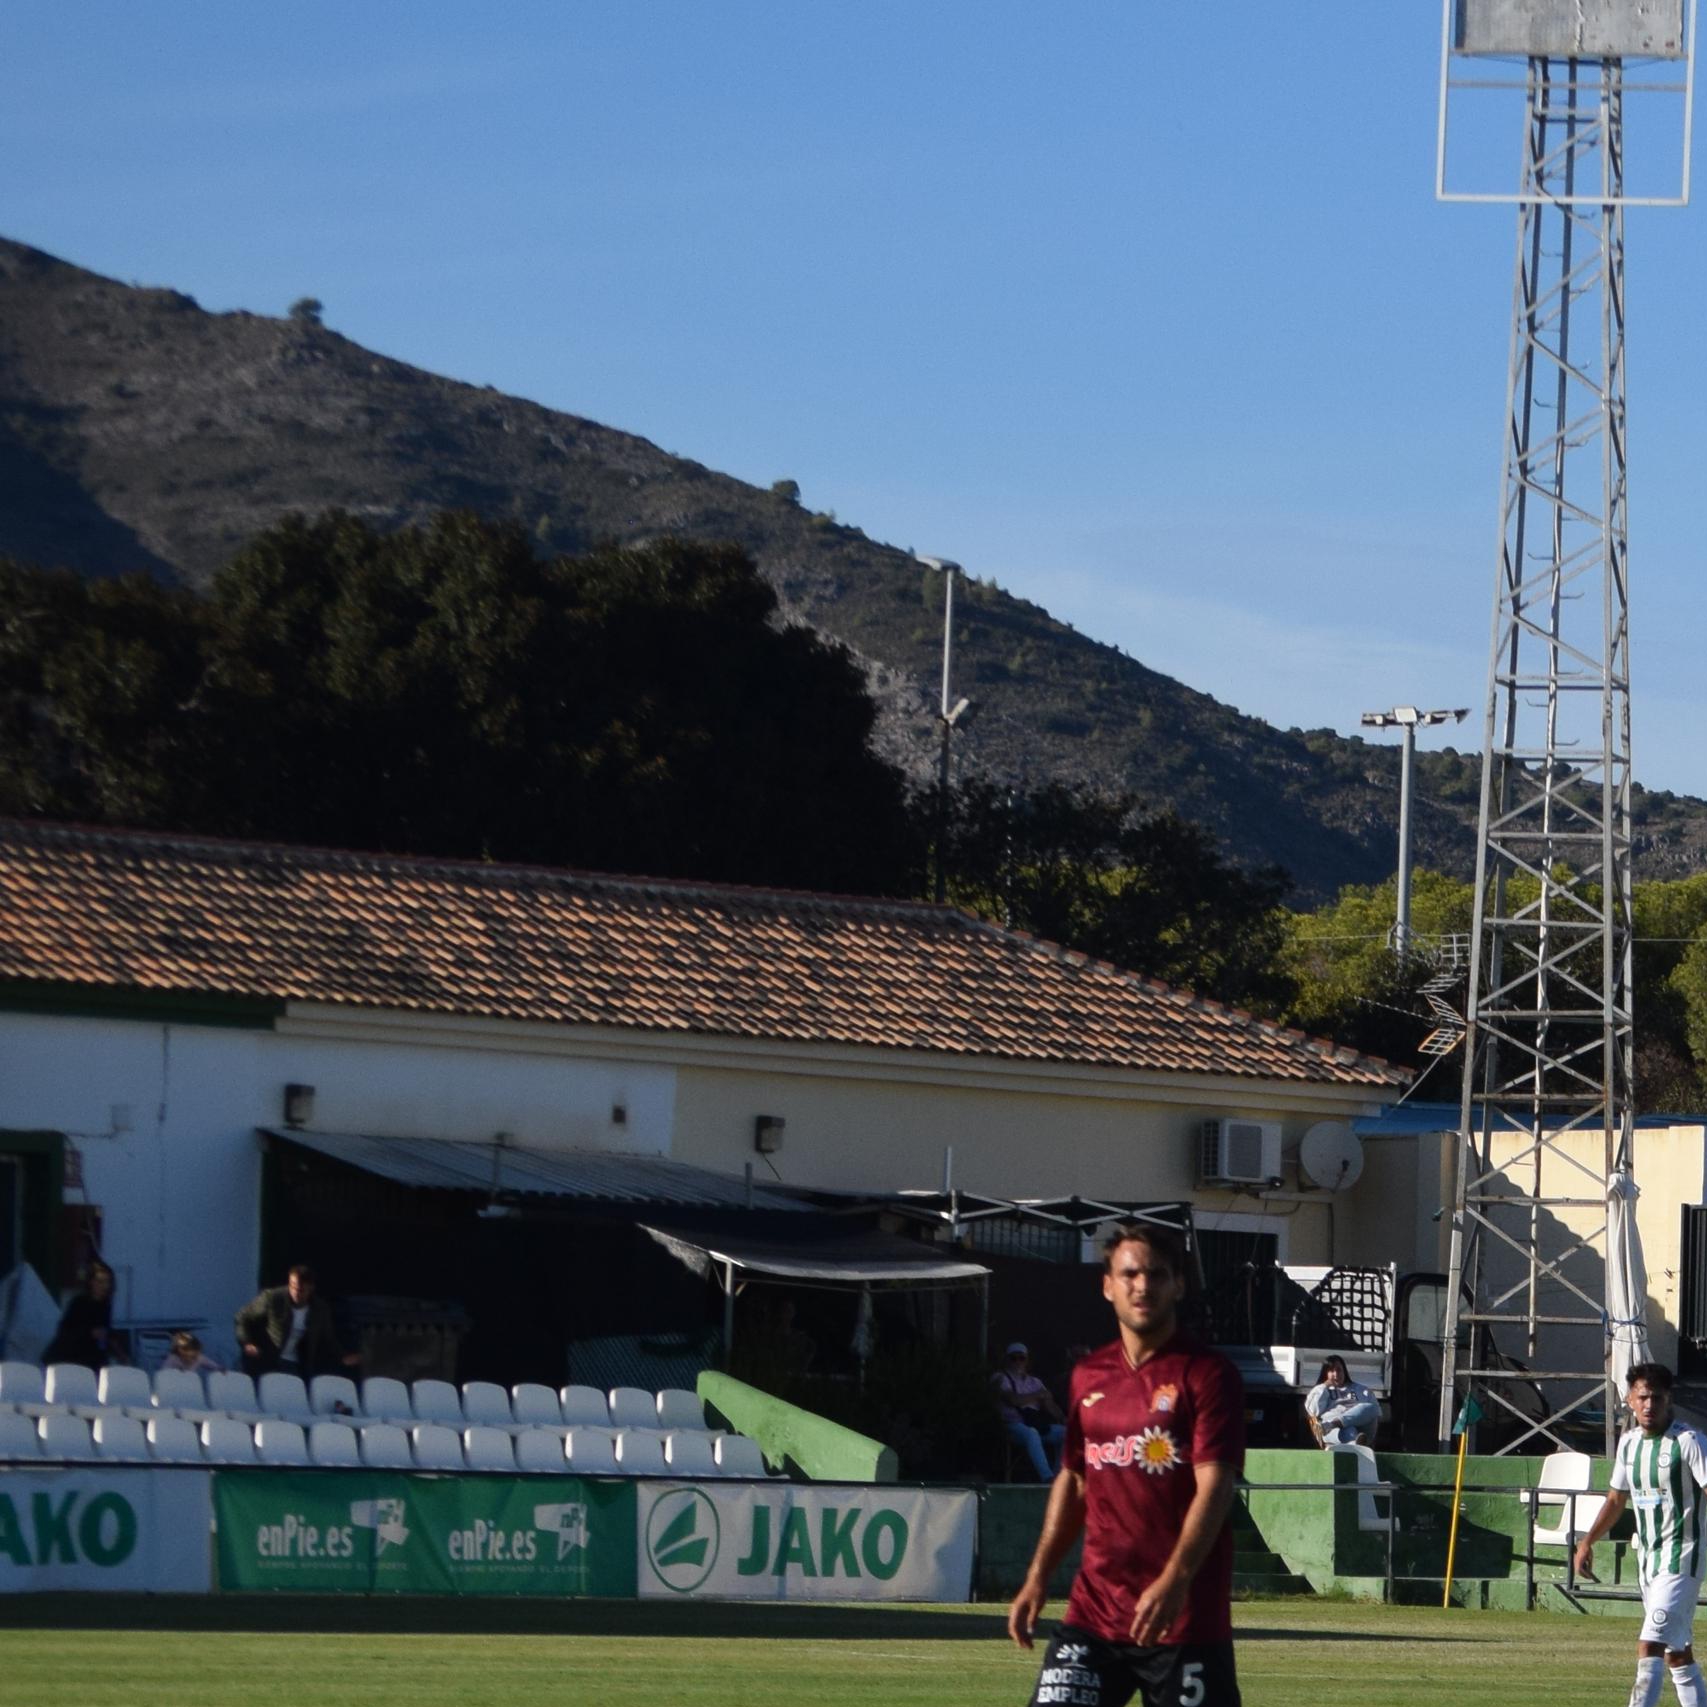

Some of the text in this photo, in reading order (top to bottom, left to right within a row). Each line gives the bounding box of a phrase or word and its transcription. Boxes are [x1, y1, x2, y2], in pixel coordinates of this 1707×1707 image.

[257, 1513, 354, 1557] enPie.es
[448, 1519, 537, 1561] enPie.es
[737, 1504, 909, 1581] JAKO
[1037, 1686, 1100, 1706] EMPLEO
[1040, 1668, 1100, 1687] MODERA
[1178, 1662, 1205, 1707] 5
